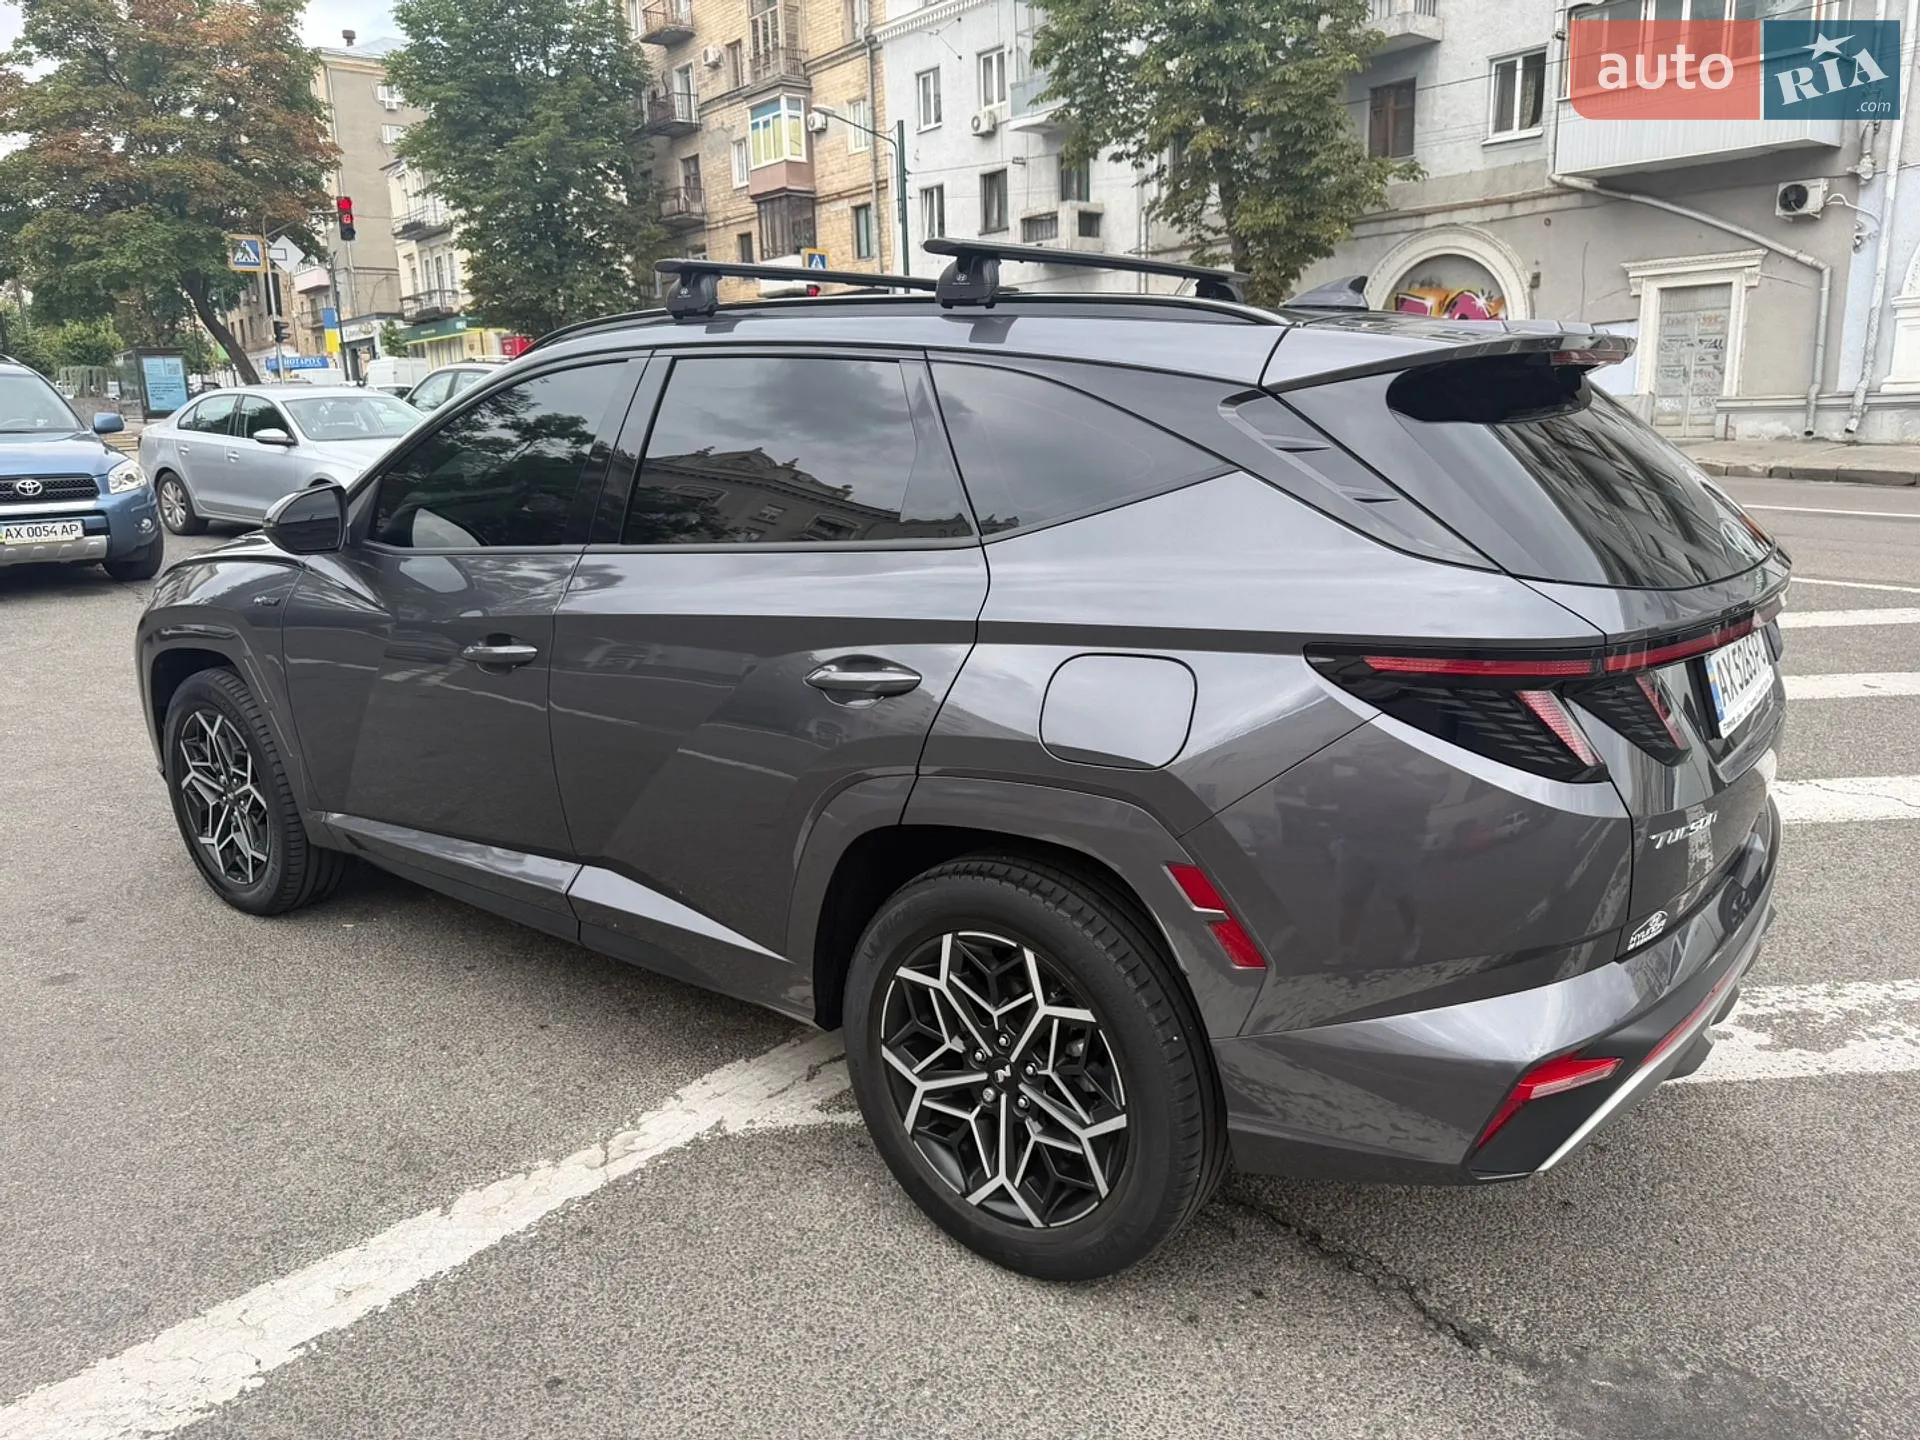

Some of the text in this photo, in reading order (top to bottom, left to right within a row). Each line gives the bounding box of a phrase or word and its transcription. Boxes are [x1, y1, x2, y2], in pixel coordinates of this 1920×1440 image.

[5, 524, 78, 540] AX 0054 AP
